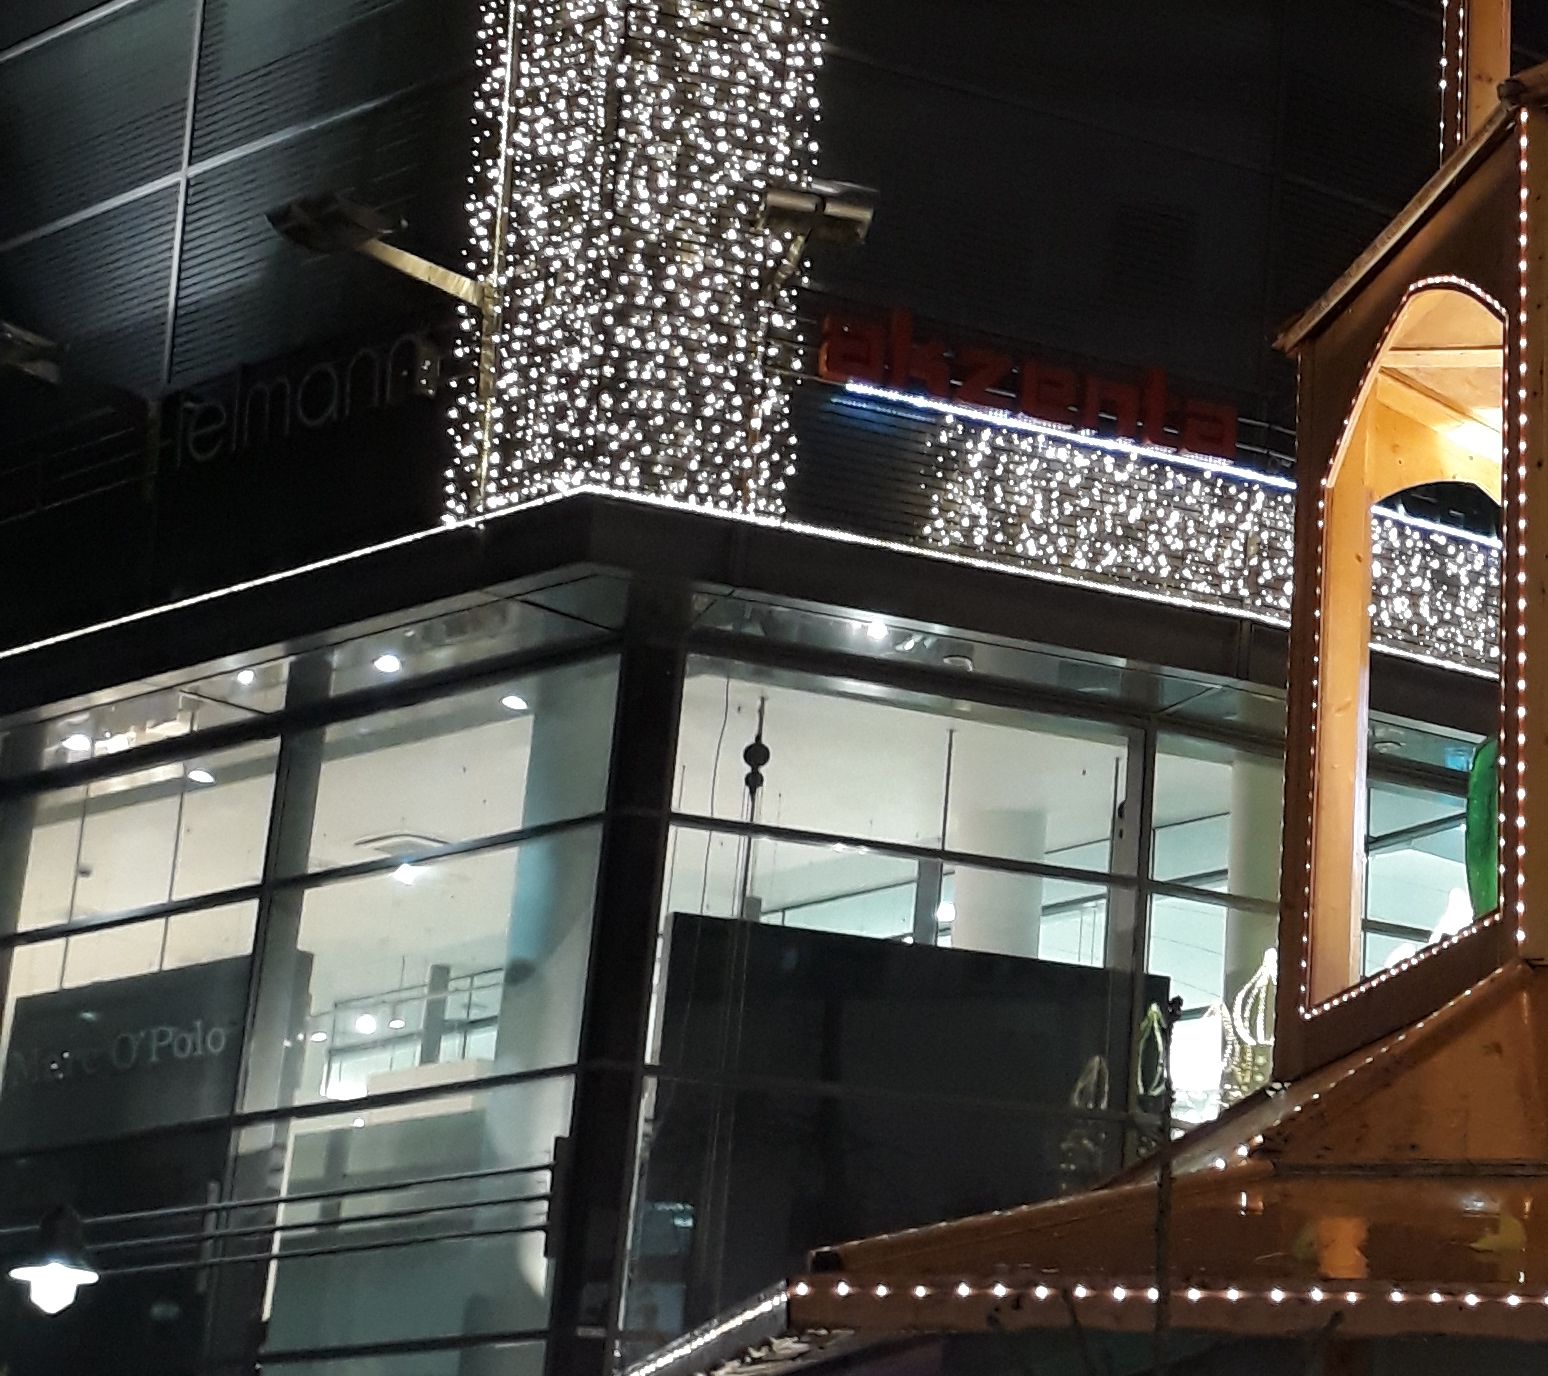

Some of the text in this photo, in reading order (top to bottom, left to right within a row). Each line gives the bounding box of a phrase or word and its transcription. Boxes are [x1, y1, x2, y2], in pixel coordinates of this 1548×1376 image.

[170, 335, 421, 469] ielmann
[816, 309, 1238, 461] akzenta
[113, 1020, 227, 1071] O'Polo
